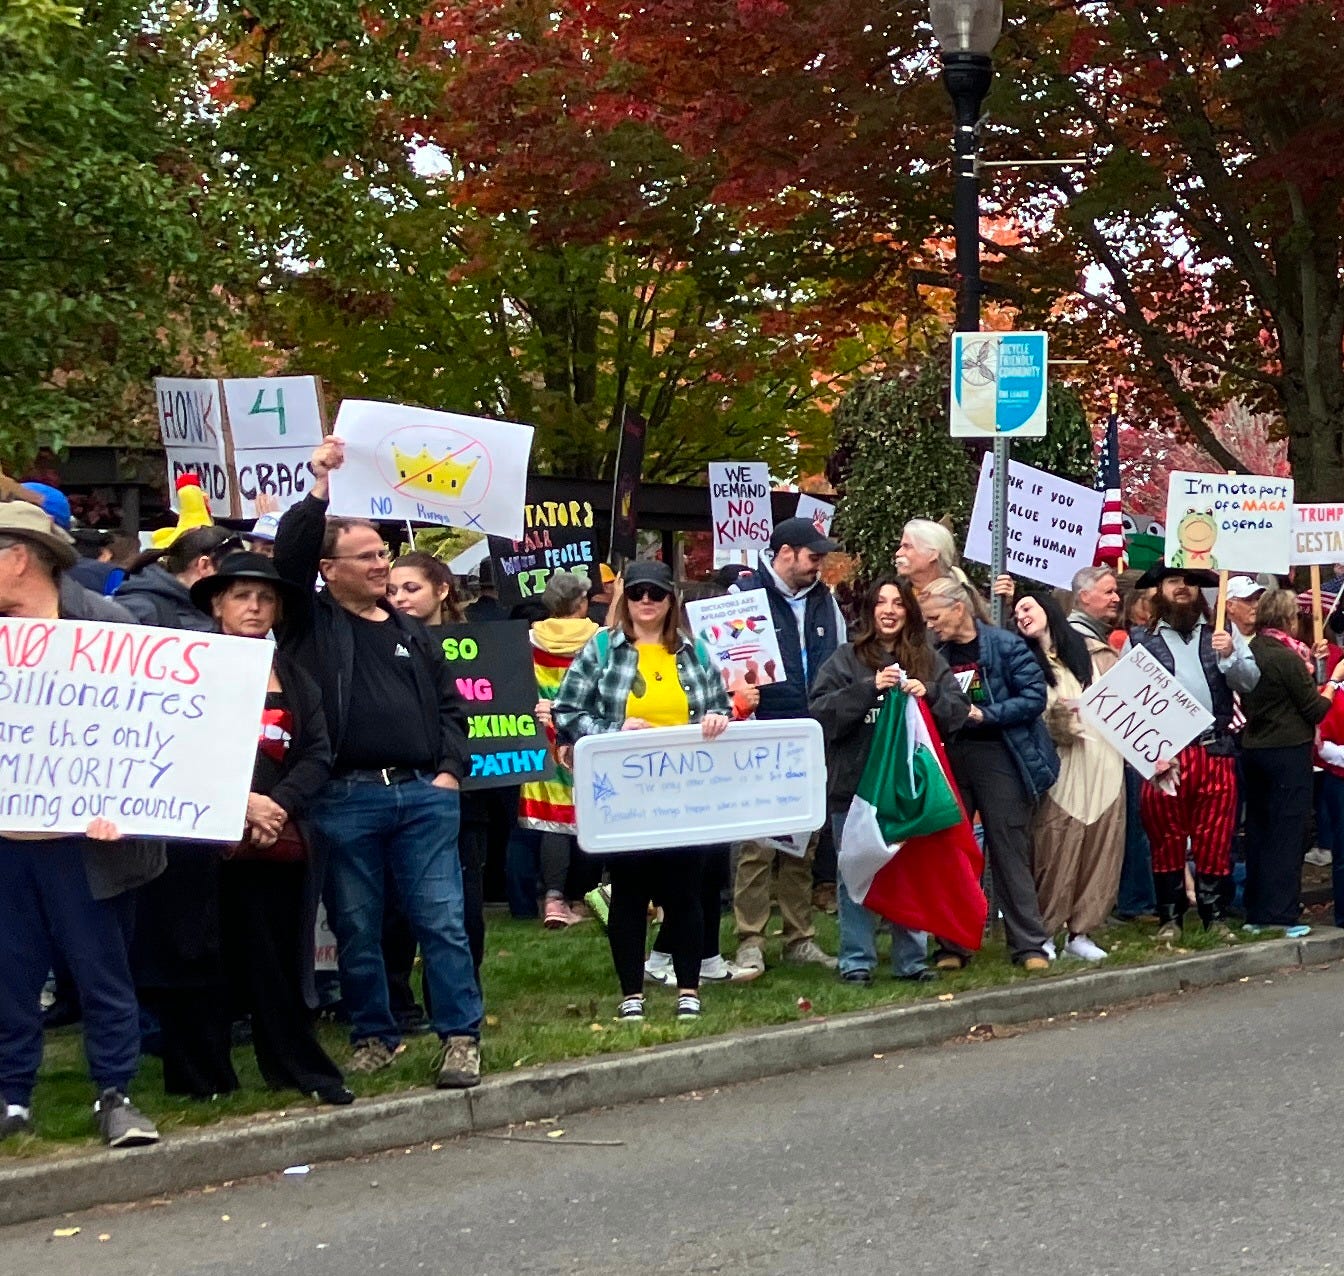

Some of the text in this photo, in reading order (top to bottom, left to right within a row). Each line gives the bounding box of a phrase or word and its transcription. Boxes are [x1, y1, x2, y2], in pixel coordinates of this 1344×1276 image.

[161, 388, 287, 444] HONK 4
[724, 466, 753, 483] WE
[713, 483, 767, 499] DEMAND
[1032, 484, 1075, 507] IF YOU
[1185, 478, 1213, 495] I'm
[1217, 483, 1246, 495] not
[1259, 485, 1288, 498] part
[371, 497, 392, 516] NO
[728, 500, 754, 518] NO
[1242, 500, 1285, 511] MAGA
[716, 517, 770, 544] KINGS
[1051, 517, 1083, 536] YOUR
[1222, 518, 1273, 533] agenda
[545, 541, 593, 568] PEOPLE
[1033, 535, 1077, 558] HUMAN
[738, 605, 758, 614] UNITY
[70, 628, 210, 685] KINGS
[442, 638, 478, 661] SO
[0, 670, 206, 719] Billionaires
[1130, 651, 1201, 717] SLOTHS HAVE
[1133, 684, 1170, 716] NO
[1086, 686, 1173, 763] KINGS
[50, 720, 99, 747] the
[113, 721, 175, 760] only
[0, 753, 174, 789] MINORITY
[622, 751, 714, 779] STAND
[734, 742, 782, 771] UP!
[71, 794, 116, 818] our
[120, 796, 210, 830] country
